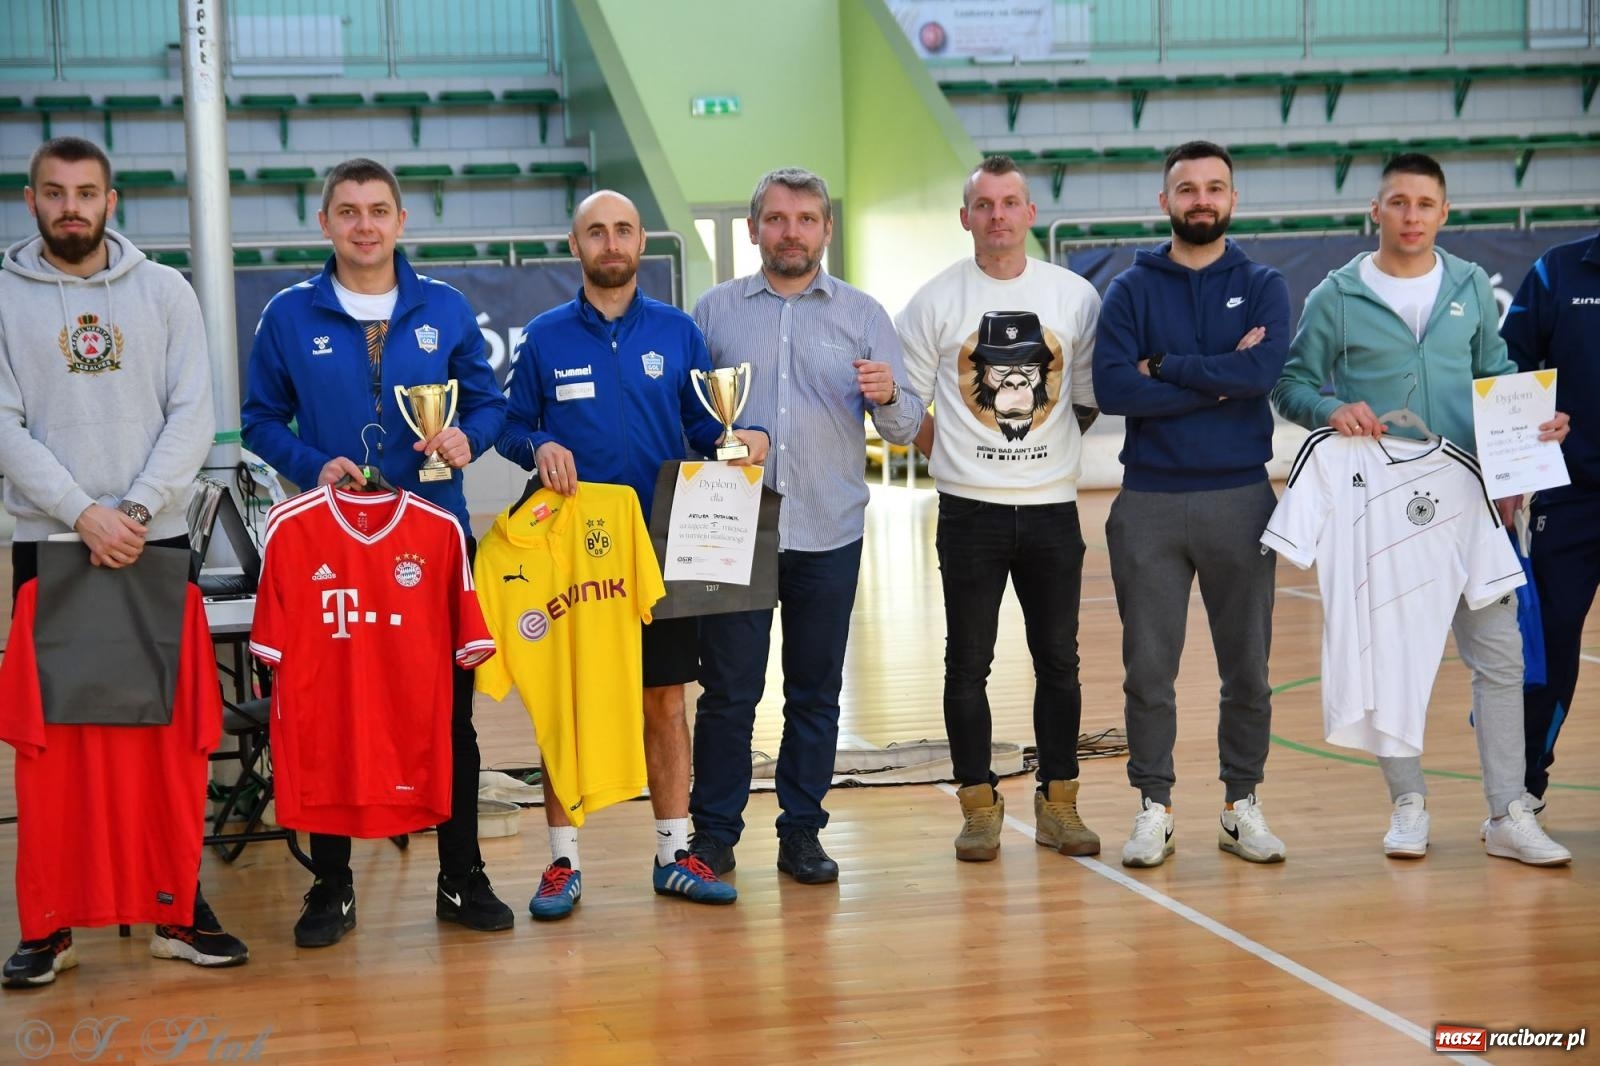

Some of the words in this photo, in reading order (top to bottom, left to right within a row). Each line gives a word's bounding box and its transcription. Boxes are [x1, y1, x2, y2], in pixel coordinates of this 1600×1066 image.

[554, 364, 592, 379] hummel
[700, 478, 736, 490] Dyplom
[710, 492, 724, 502] dla
[1536, 516, 1547, 532] 15
[587, 532, 610, 550] BVB
[312, 572, 336, 581] adidas
[706, 584, 720, 592] 1217
